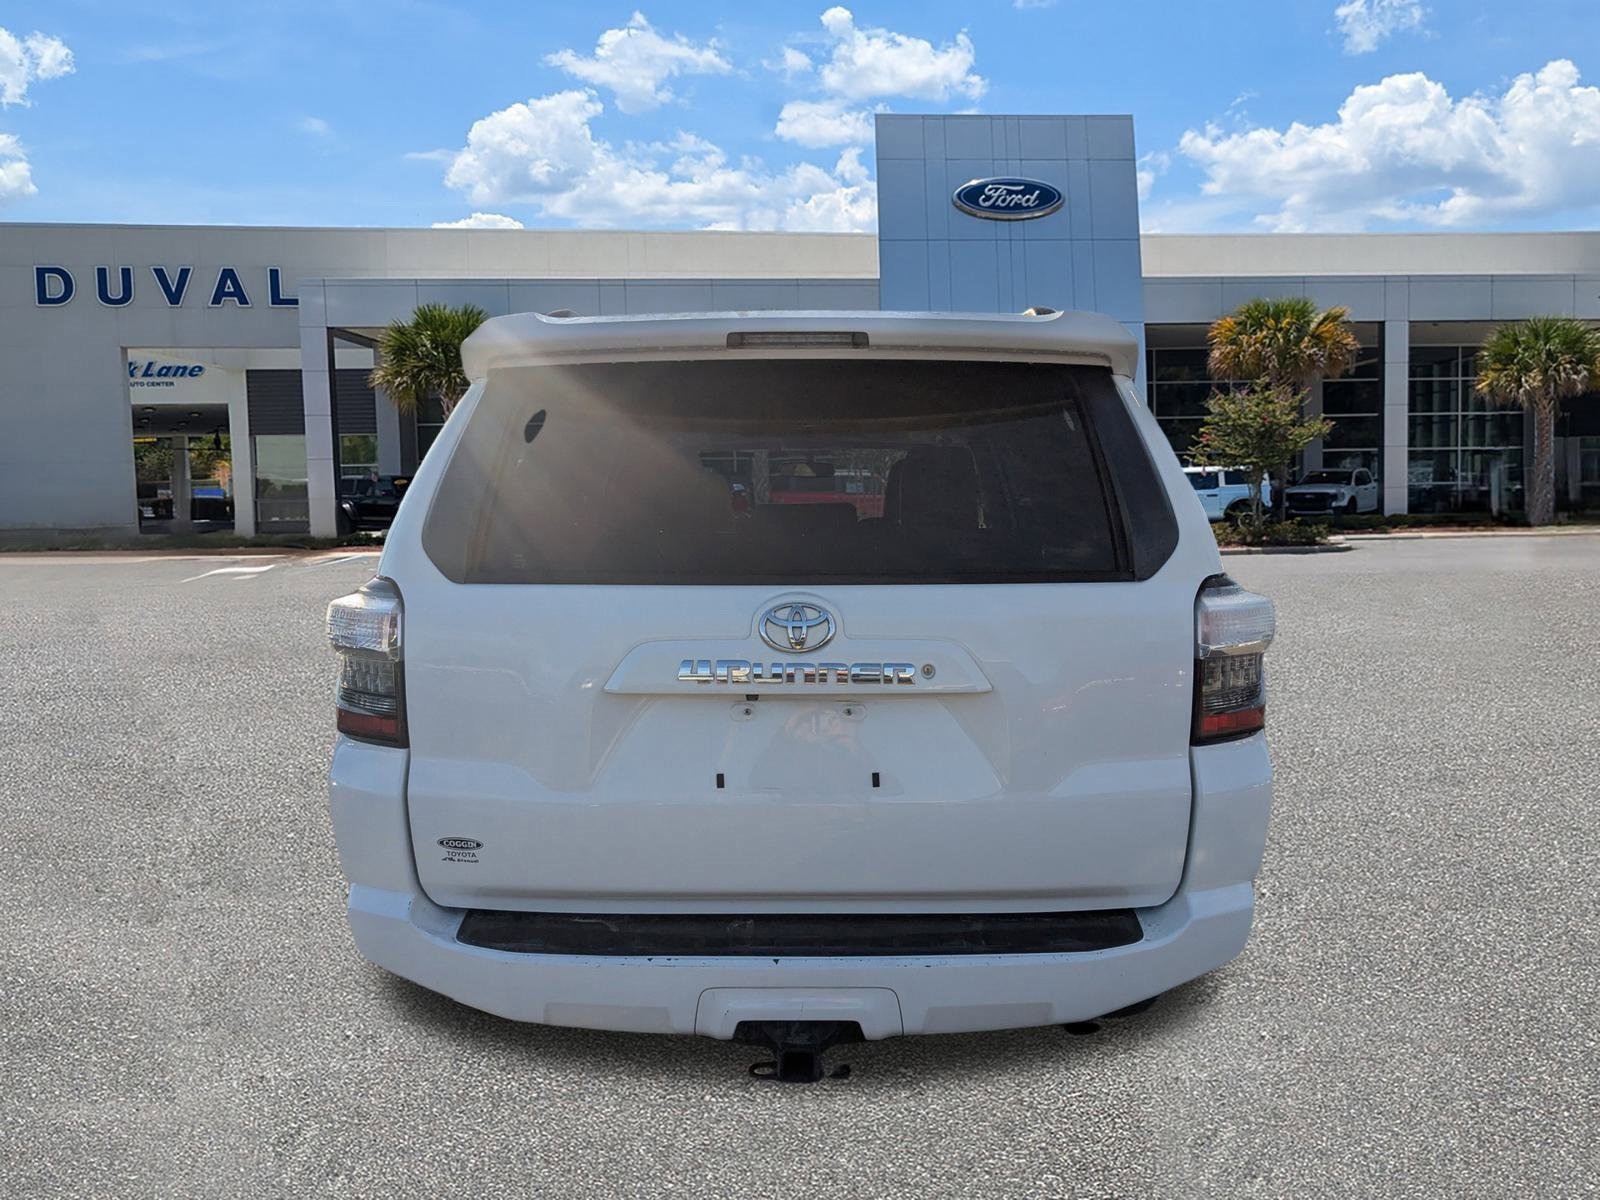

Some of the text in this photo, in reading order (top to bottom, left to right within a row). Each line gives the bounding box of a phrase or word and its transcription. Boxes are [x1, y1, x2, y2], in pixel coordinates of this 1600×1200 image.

[979, 184, 1040, 207] Ford
[33, 265, 299, 307] DUVAL
[142, 361, 204, 377] Lane
[678, 659, 916, 684] 4RUNNER
[446, 850, 477, 858] TOYOTA
